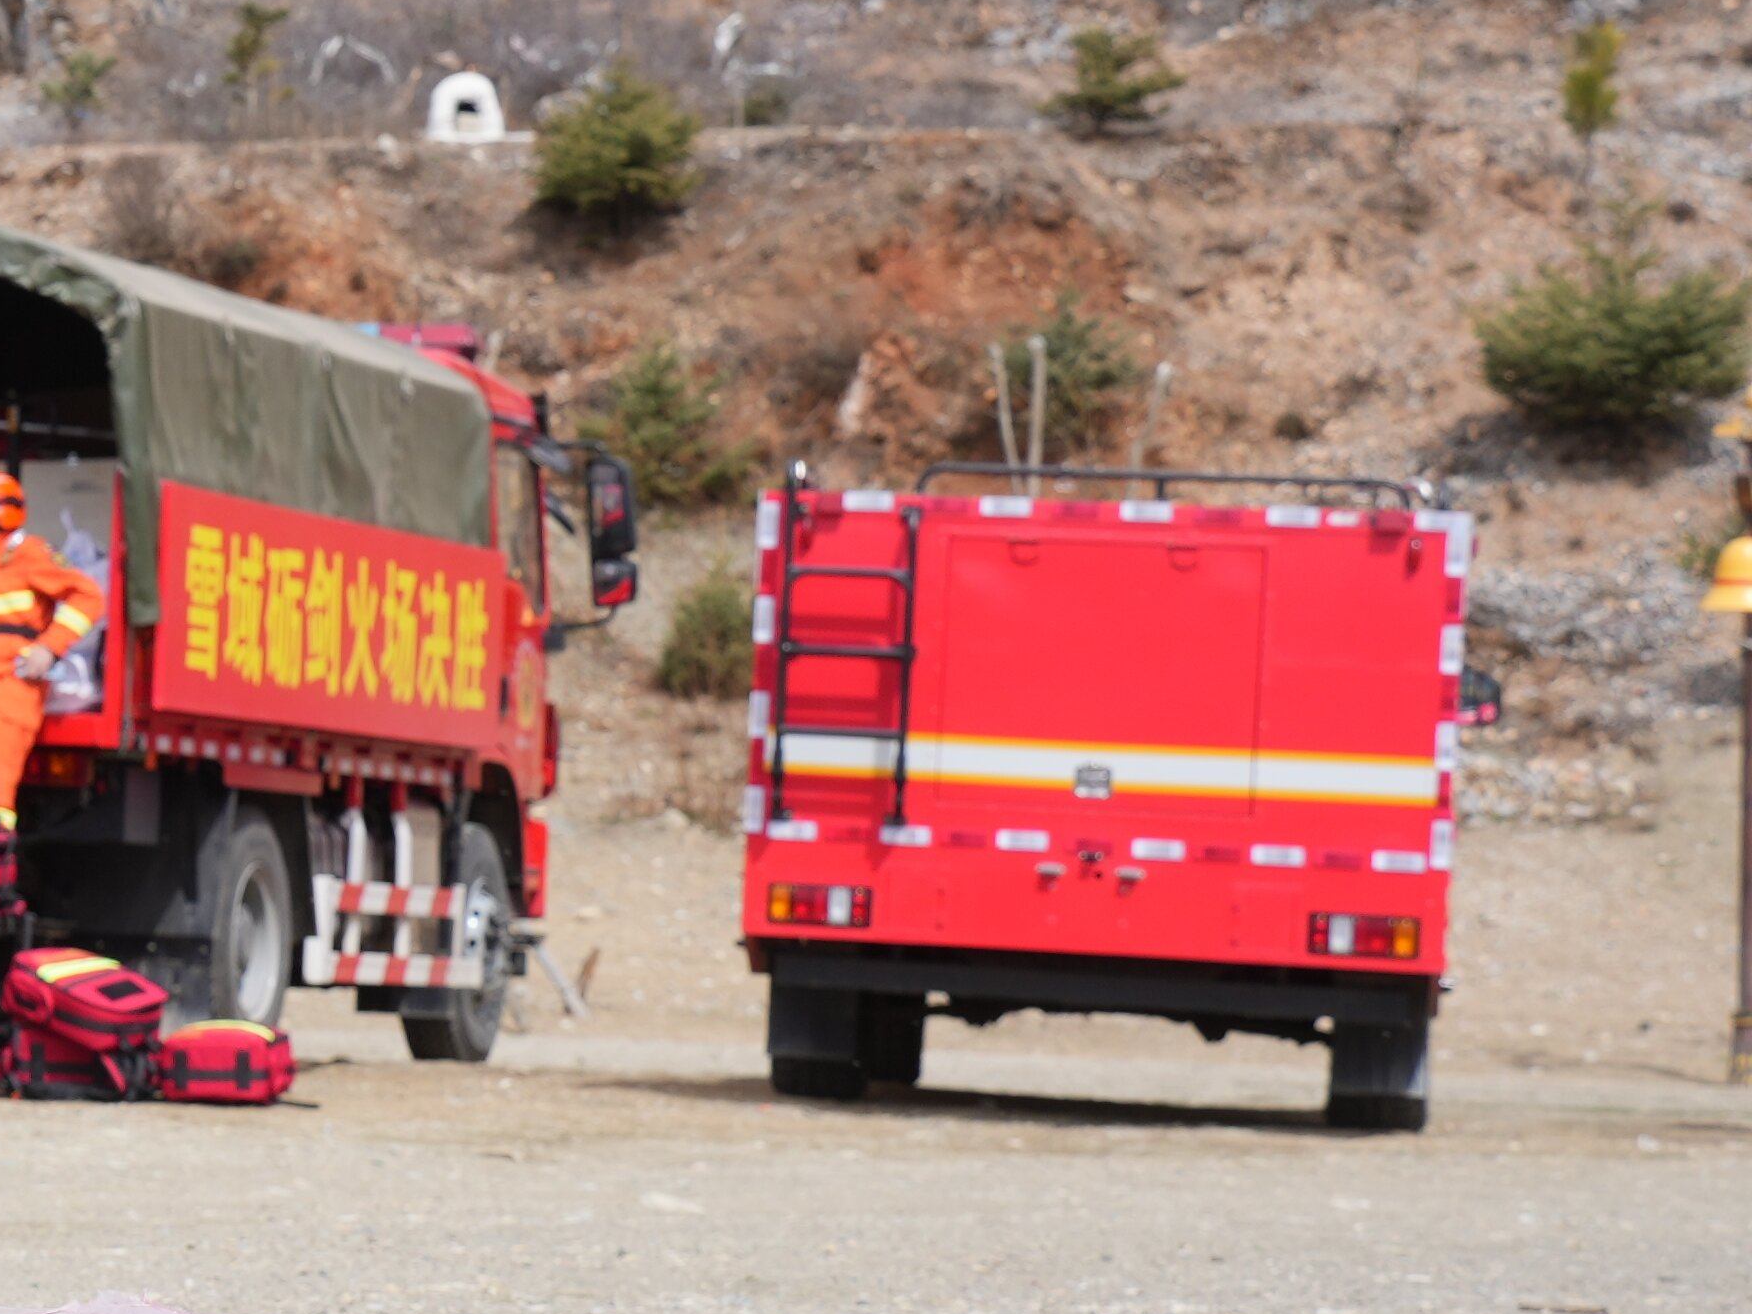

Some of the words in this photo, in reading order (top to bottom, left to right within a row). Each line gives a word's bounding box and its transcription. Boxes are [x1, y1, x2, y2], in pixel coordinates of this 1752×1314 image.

[184, 522, 490, 713] 雪域砺剑火场决胜
